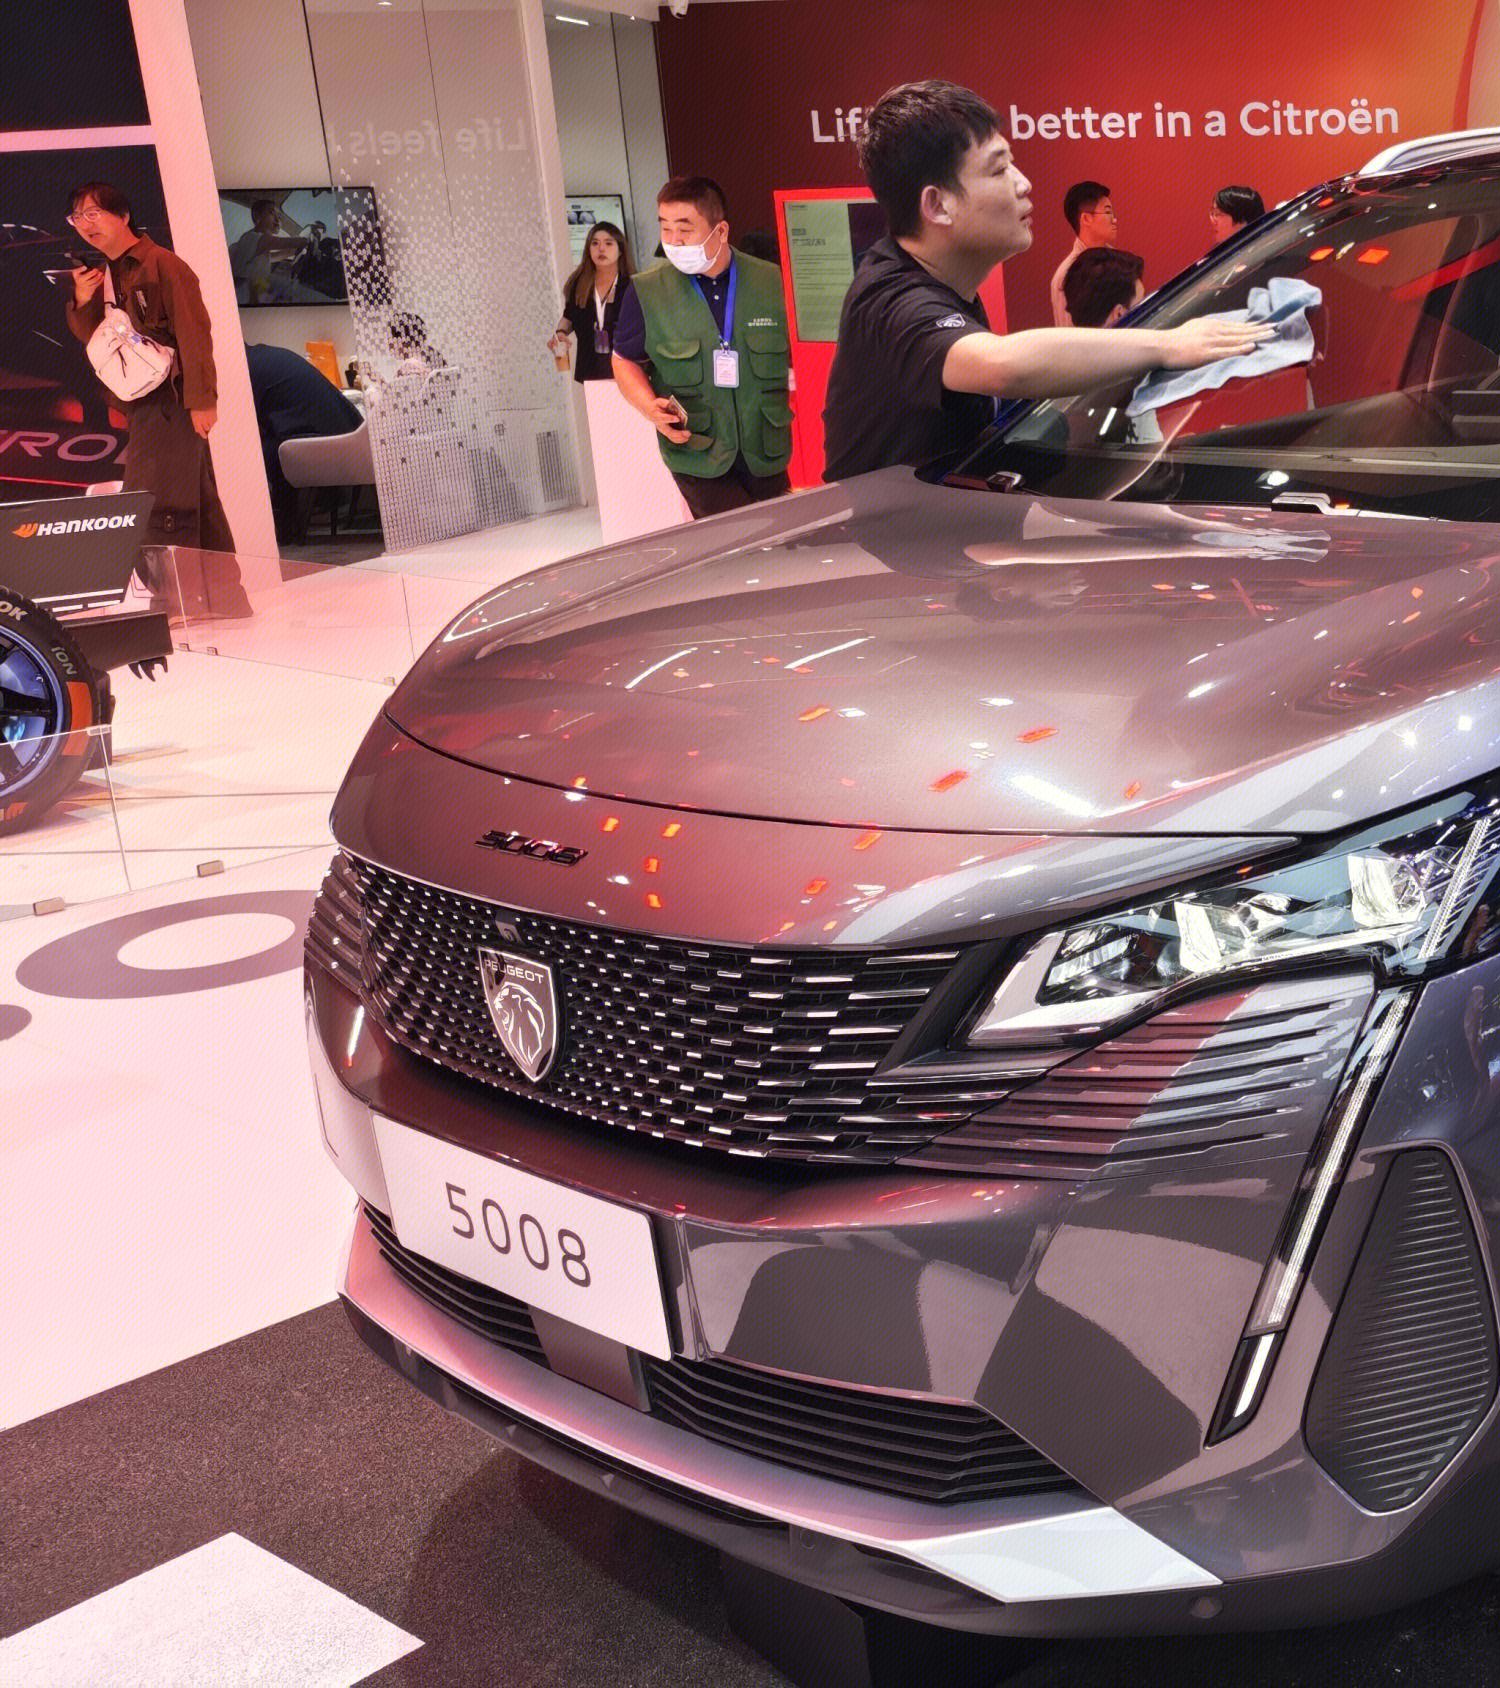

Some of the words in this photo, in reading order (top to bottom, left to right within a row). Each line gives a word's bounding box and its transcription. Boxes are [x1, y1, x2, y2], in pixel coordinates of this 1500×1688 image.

[811, 107, 869, 143] Lif
[1010, 104, 1142, 140] better
[1154, 102, 1191, 138] in
[1204, 110, 1226, 137] a
[1240, 98, 1399, 137] Citroën
[484, 958, 544, 985] PEUGEOT
[445, 1181, 592, 1288] 5008
